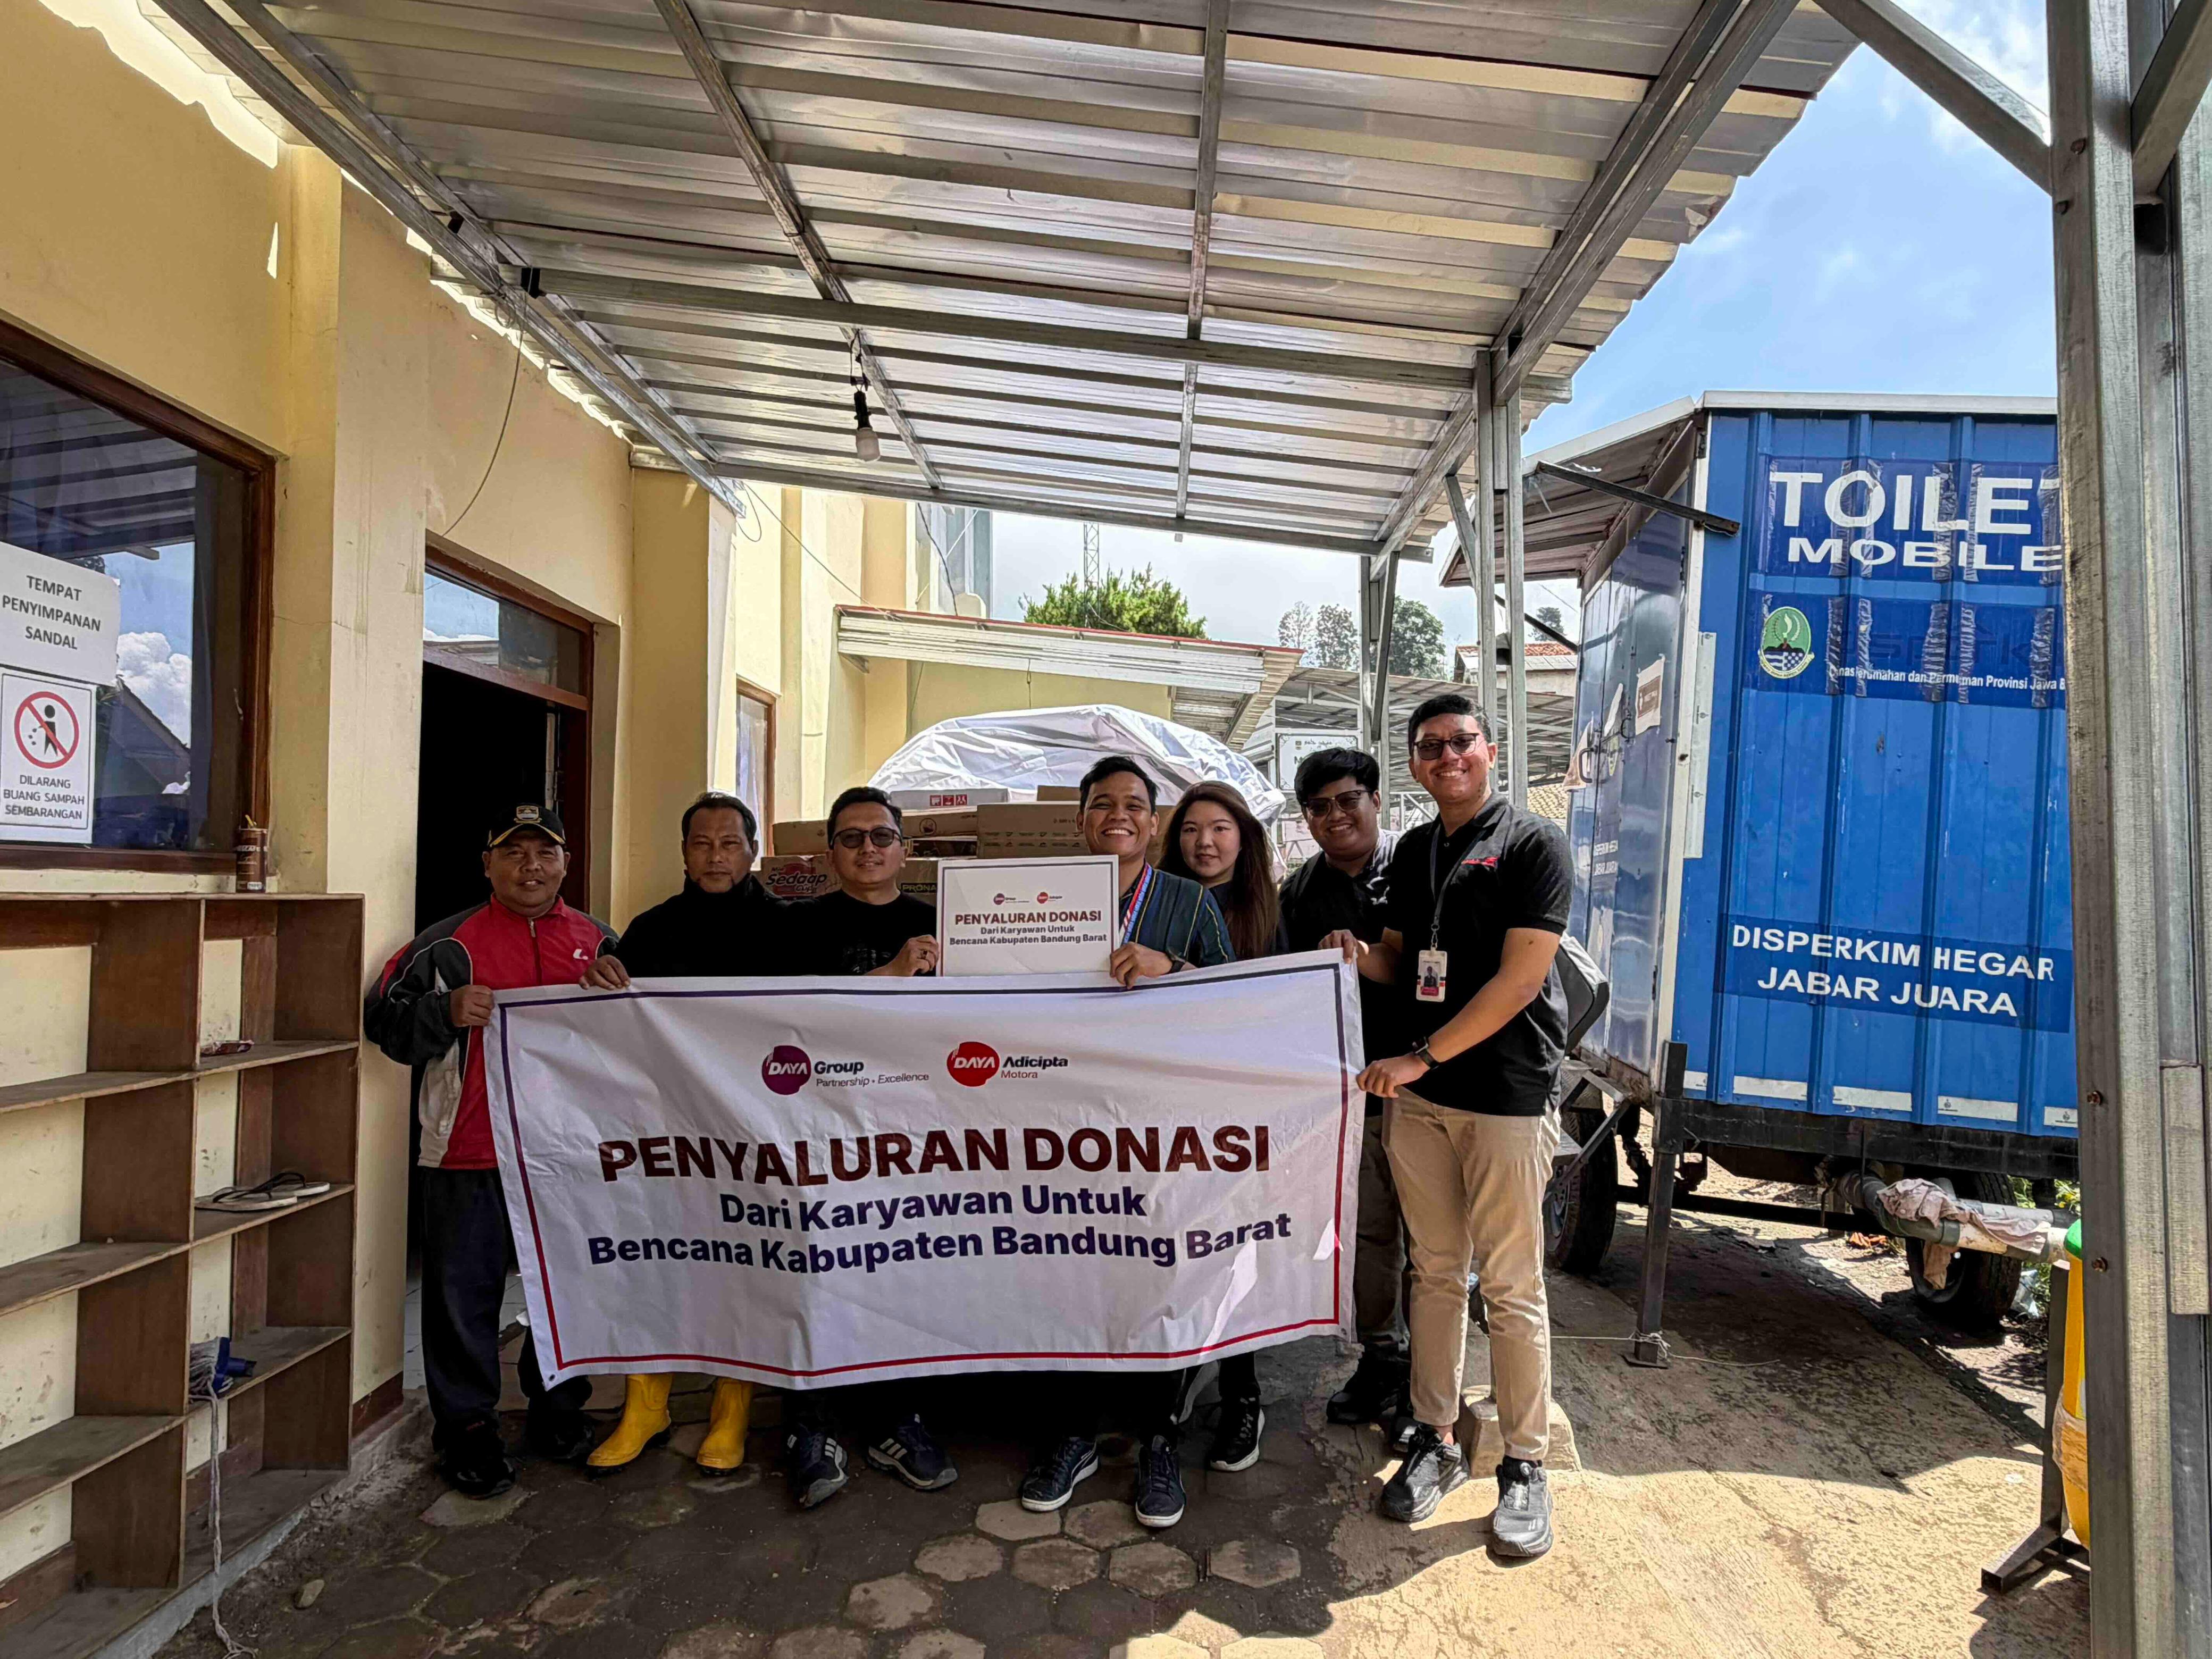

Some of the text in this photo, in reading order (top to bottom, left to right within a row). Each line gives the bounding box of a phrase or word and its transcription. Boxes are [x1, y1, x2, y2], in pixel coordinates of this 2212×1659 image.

[1788, 537, 2062, 572] MOBILE
[26, 575, 82, 601] TEMPAT
[2, 595, 100, 632] PENYIMPANAN
[25, 626, 78, 650] SANDAL
[1856, 667, 1906, 682] erumahan
[1908, 670, 1926, 683] dan
[1986, 675, 2027, 689] Provinsi
[2030, 678, 2057, 690] Jawa
[20, 775, 71, 789] DILARANG
[3, 789, 85, 805] BUANG SAMPAH
[5, 805, 82, 819] SEMBARANGAN
[766, 872, 827, 886] Sedaap
[955, 910, 1101, 925] PENYALURAN DONASI
[981, 926, 999, 935] Dari
[1000, 926, 1046, 935] Karyawan
[990, 936, 1039, 945] Kabupaten
[1041, 935, 1081, 944] Bandung
[1733, 925, 2054, 982] DISPERKIM HEGAR
[1757, 967, 2017, 1017] JABAR JUARA
[768, 1061, 865, 1076] DAYA Group
[953, 1055, 1068, 1069] DAYA Adicipta
[816, 1073, 929, 1088] Partnership Excellence
[1001, 1070, 1038, 1079] Motora
[598, 1125, 1269, 1186] PENYALURAN DONASI
[720, 1185, 1146, 1231] Dari Karyawan Untuk
[588, 1213, 1291, 1273] Bencana Kabupaten Bandung Barat
